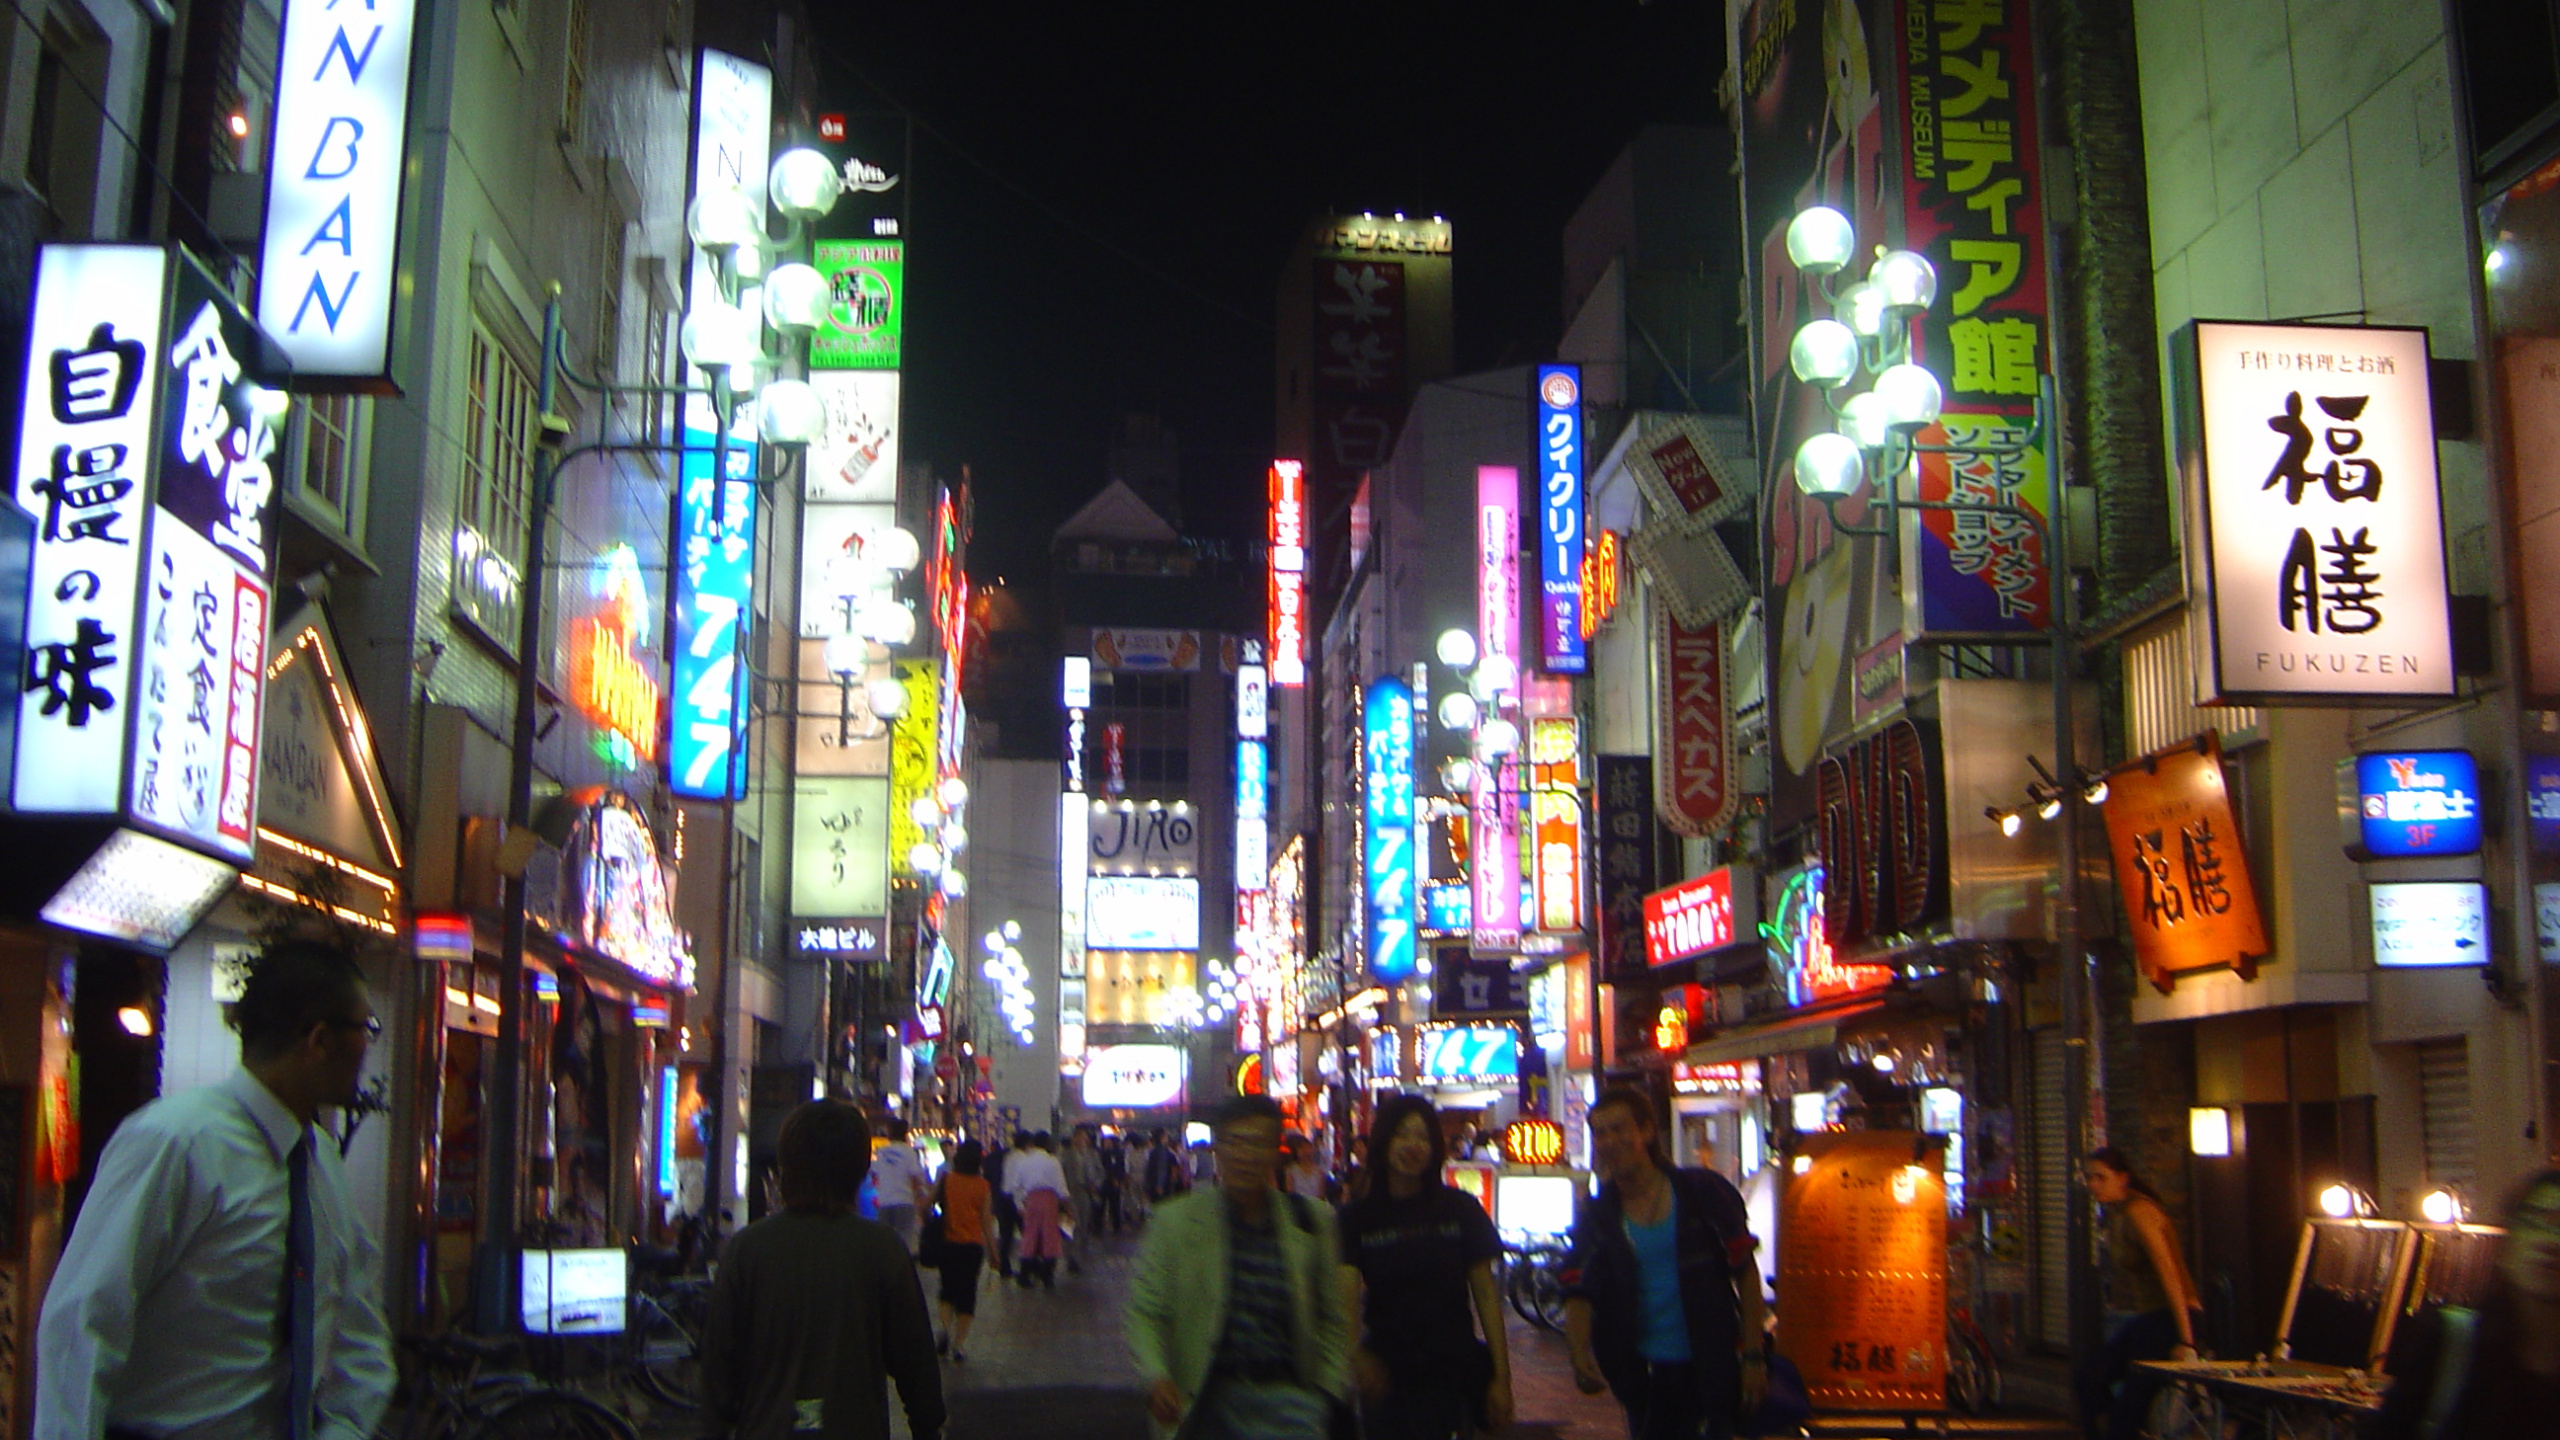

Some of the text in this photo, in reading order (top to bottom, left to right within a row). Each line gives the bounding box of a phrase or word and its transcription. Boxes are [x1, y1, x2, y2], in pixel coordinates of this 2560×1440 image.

[287, 0, 383, 335] NBAN
[1911, 75, 1934, 179] MUSEUM
[2236, 350, 2396, 376] 手作り料理とお酒
[25, 322, 147, 727] 自慢の味
[2261, 390, 2384, 636] 福膳
[684, 592, 739, 788] 747
[2257, 652, 2420, 675] FUKUZEN
[1817, 717, 1930, 947] DVD
[2132, 816, 2232, 931] 福膳
[2406, 823, 2438, 848] 3F
[1372, 827, 1408, 967] 747
[1664, 902, 1715, 956] TARO
